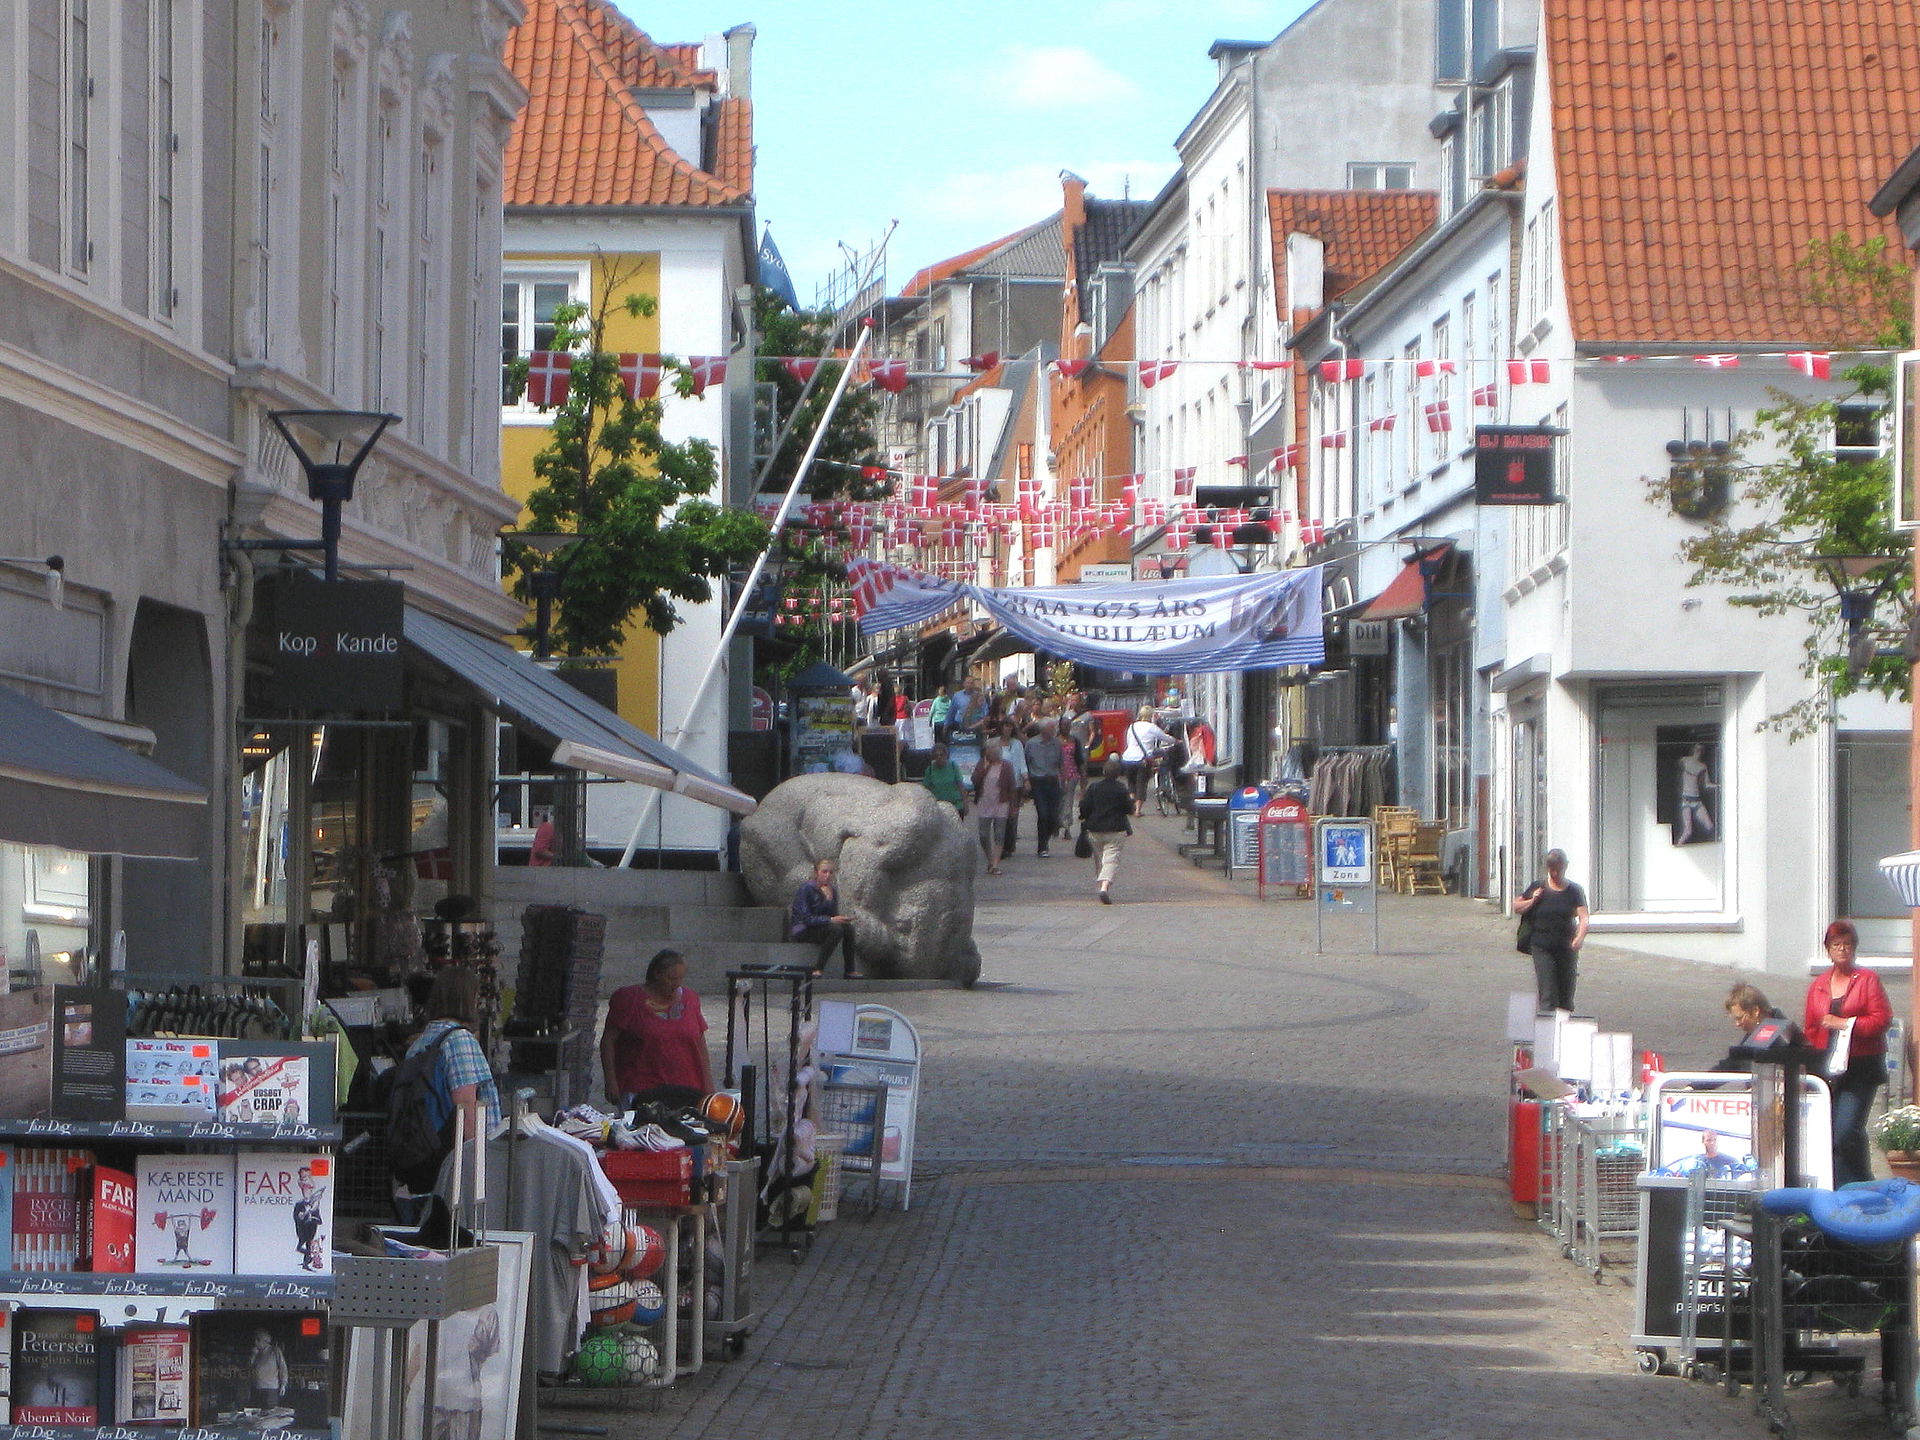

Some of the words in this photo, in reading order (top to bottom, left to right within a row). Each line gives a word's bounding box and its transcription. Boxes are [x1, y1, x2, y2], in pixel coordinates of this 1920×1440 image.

[1142, 568, 1162, 579] LEG
[1093, 600, 1142, 620] 675
[1152, 593, 1207, 617] ÅRS
[279, 632, 318, 656] Kop
[336, 632, 398, 653] Kande
[1333, 871, 1360, 879] Zone
[253, 1097, 283, 1111] CRAP
[148, 1171, 224, 1187] KÆRESTE
[244, 1171, 293, 1195] FAR
[101, 1179, 134, 1209] FAR
[157, 1188, 214, 1203] MAND
[260, 1195, 293, 1205] FÆRDE
[30, 1210, 71, 1222] STOP
[20, 1331, 96, 1354] Petersen
[18, 1409, 61, 1423] Åbenrå
[65, 1411, 92, 1423] Noir
